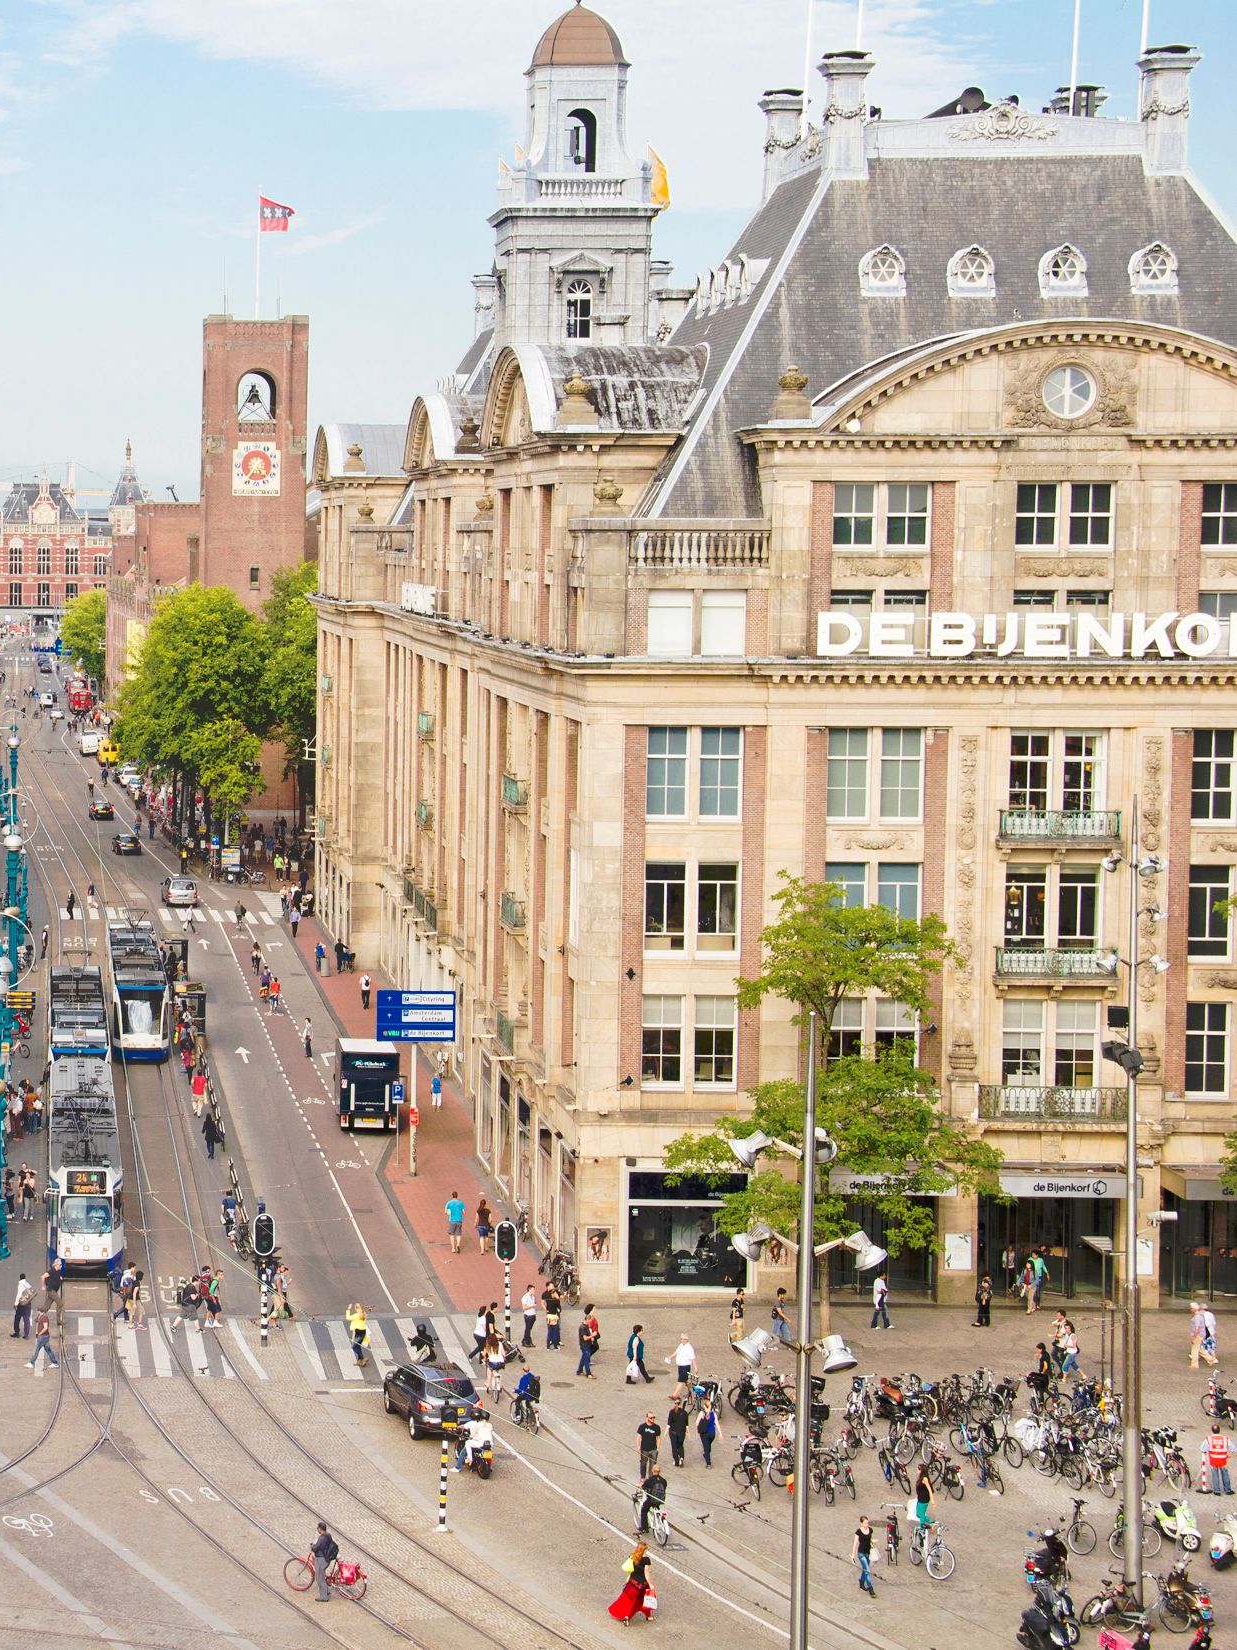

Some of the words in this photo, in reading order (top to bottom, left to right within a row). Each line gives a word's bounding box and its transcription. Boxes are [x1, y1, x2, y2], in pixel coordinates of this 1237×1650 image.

[817, 612, 914, 656] DE
[76, 1173, 88, 1183] 24
[1033, 1182, 1046, 1192] de
[1047, 1182, 1091, 1194] Bijenkorf
[139, 1487, 222, 1504] BUS
